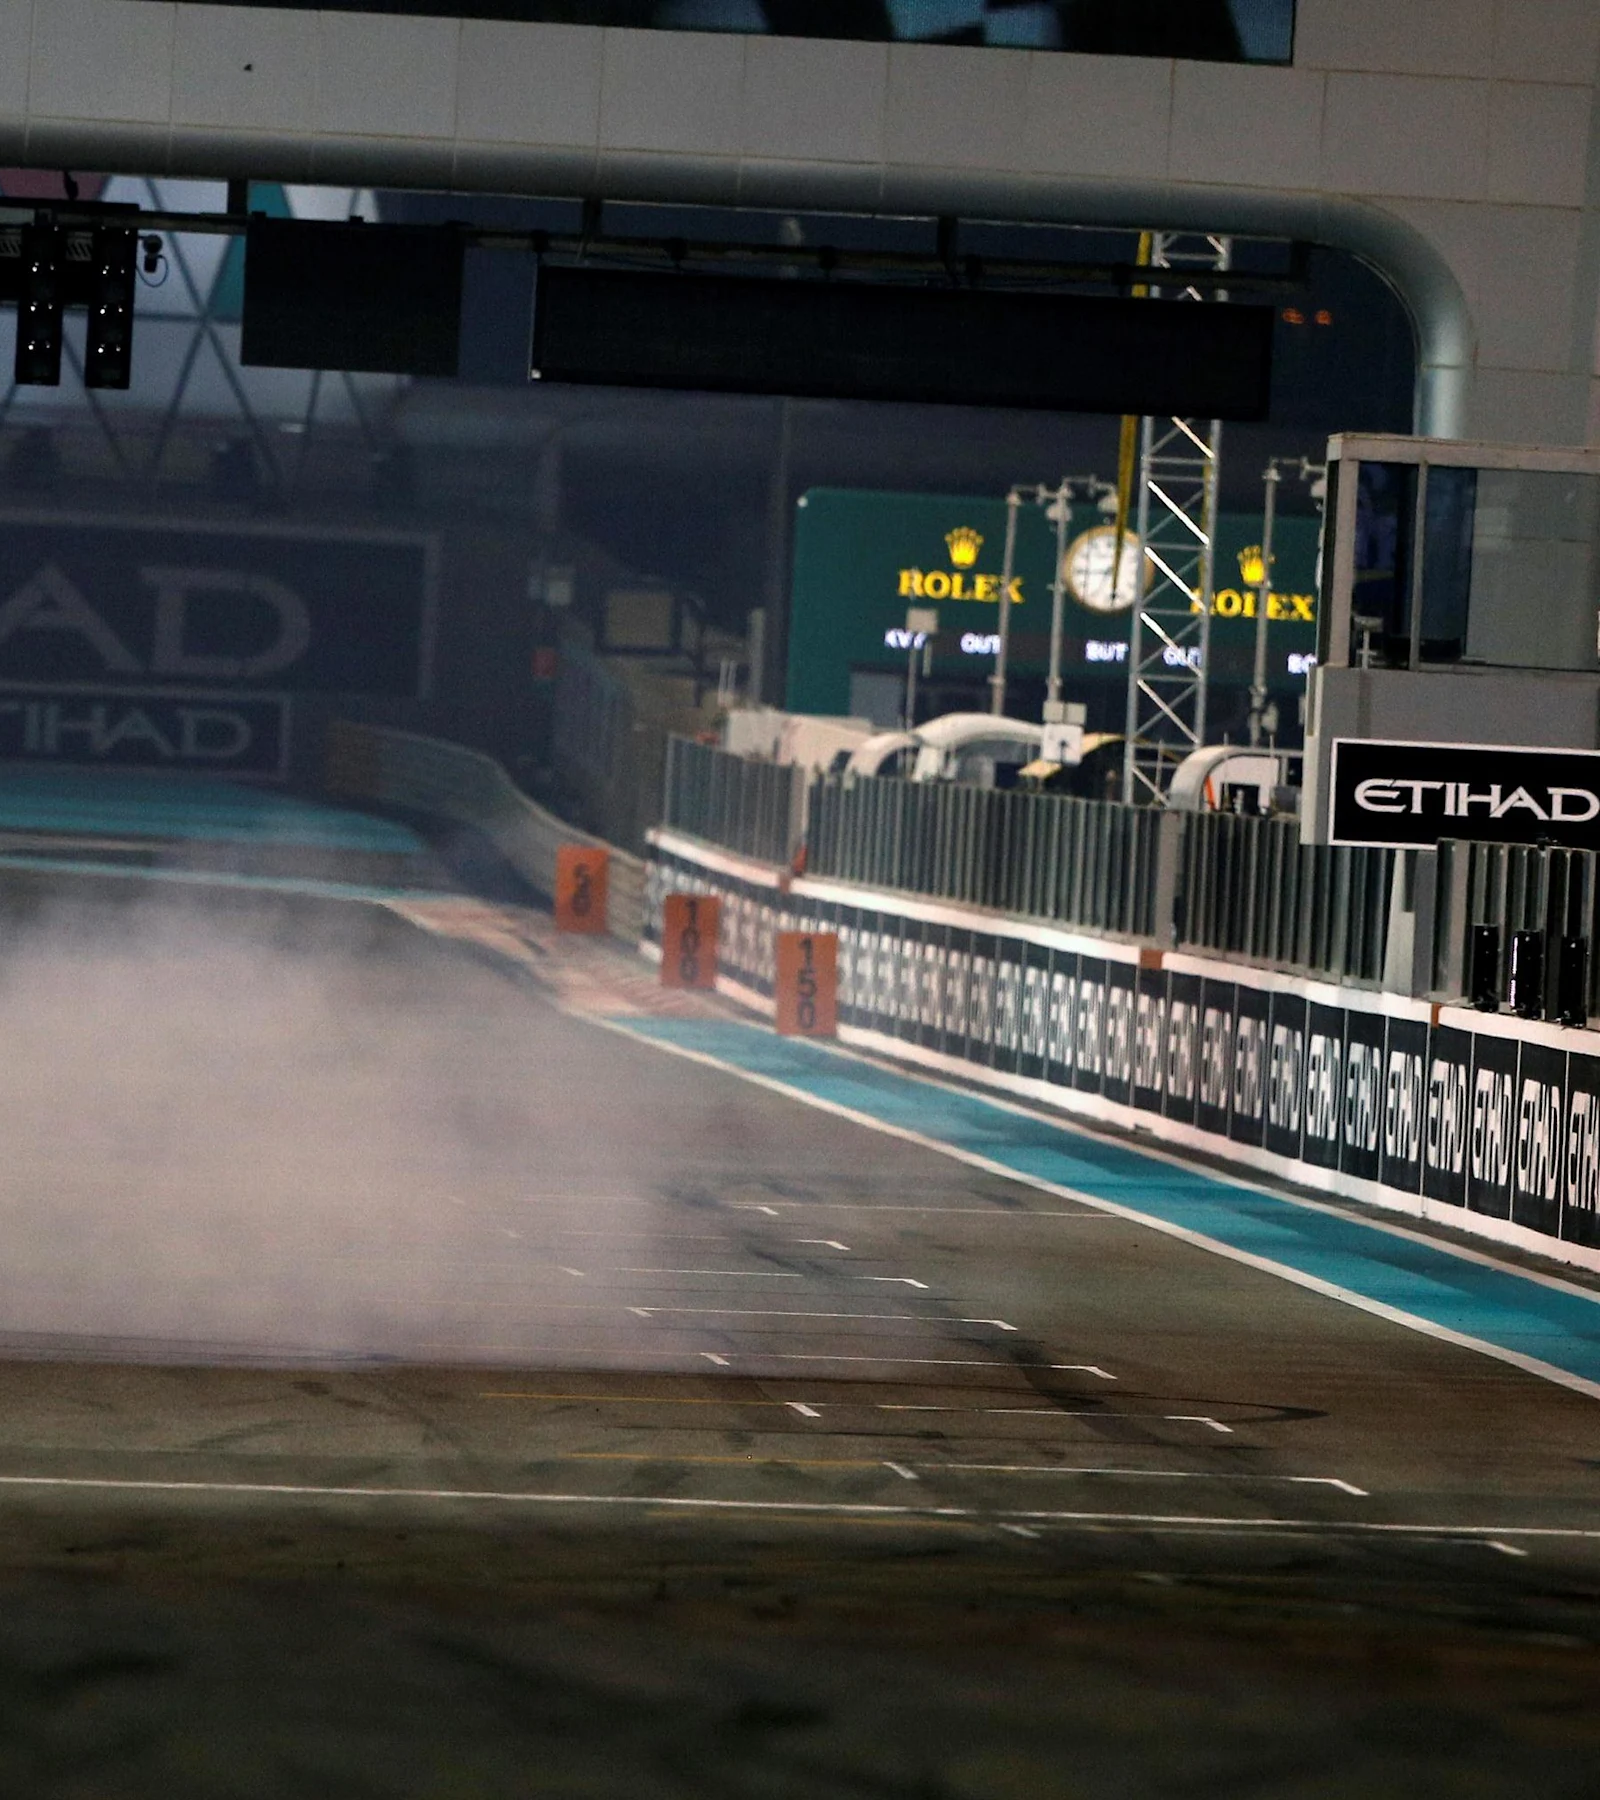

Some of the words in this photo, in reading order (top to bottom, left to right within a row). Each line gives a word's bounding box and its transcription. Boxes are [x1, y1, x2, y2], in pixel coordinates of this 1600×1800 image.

[898, 568, 1025, 604] ROLEX
[1354, 777, 1600, 823] ETIHAD
[1567, 1090, 1600, 1214] ETIHA
